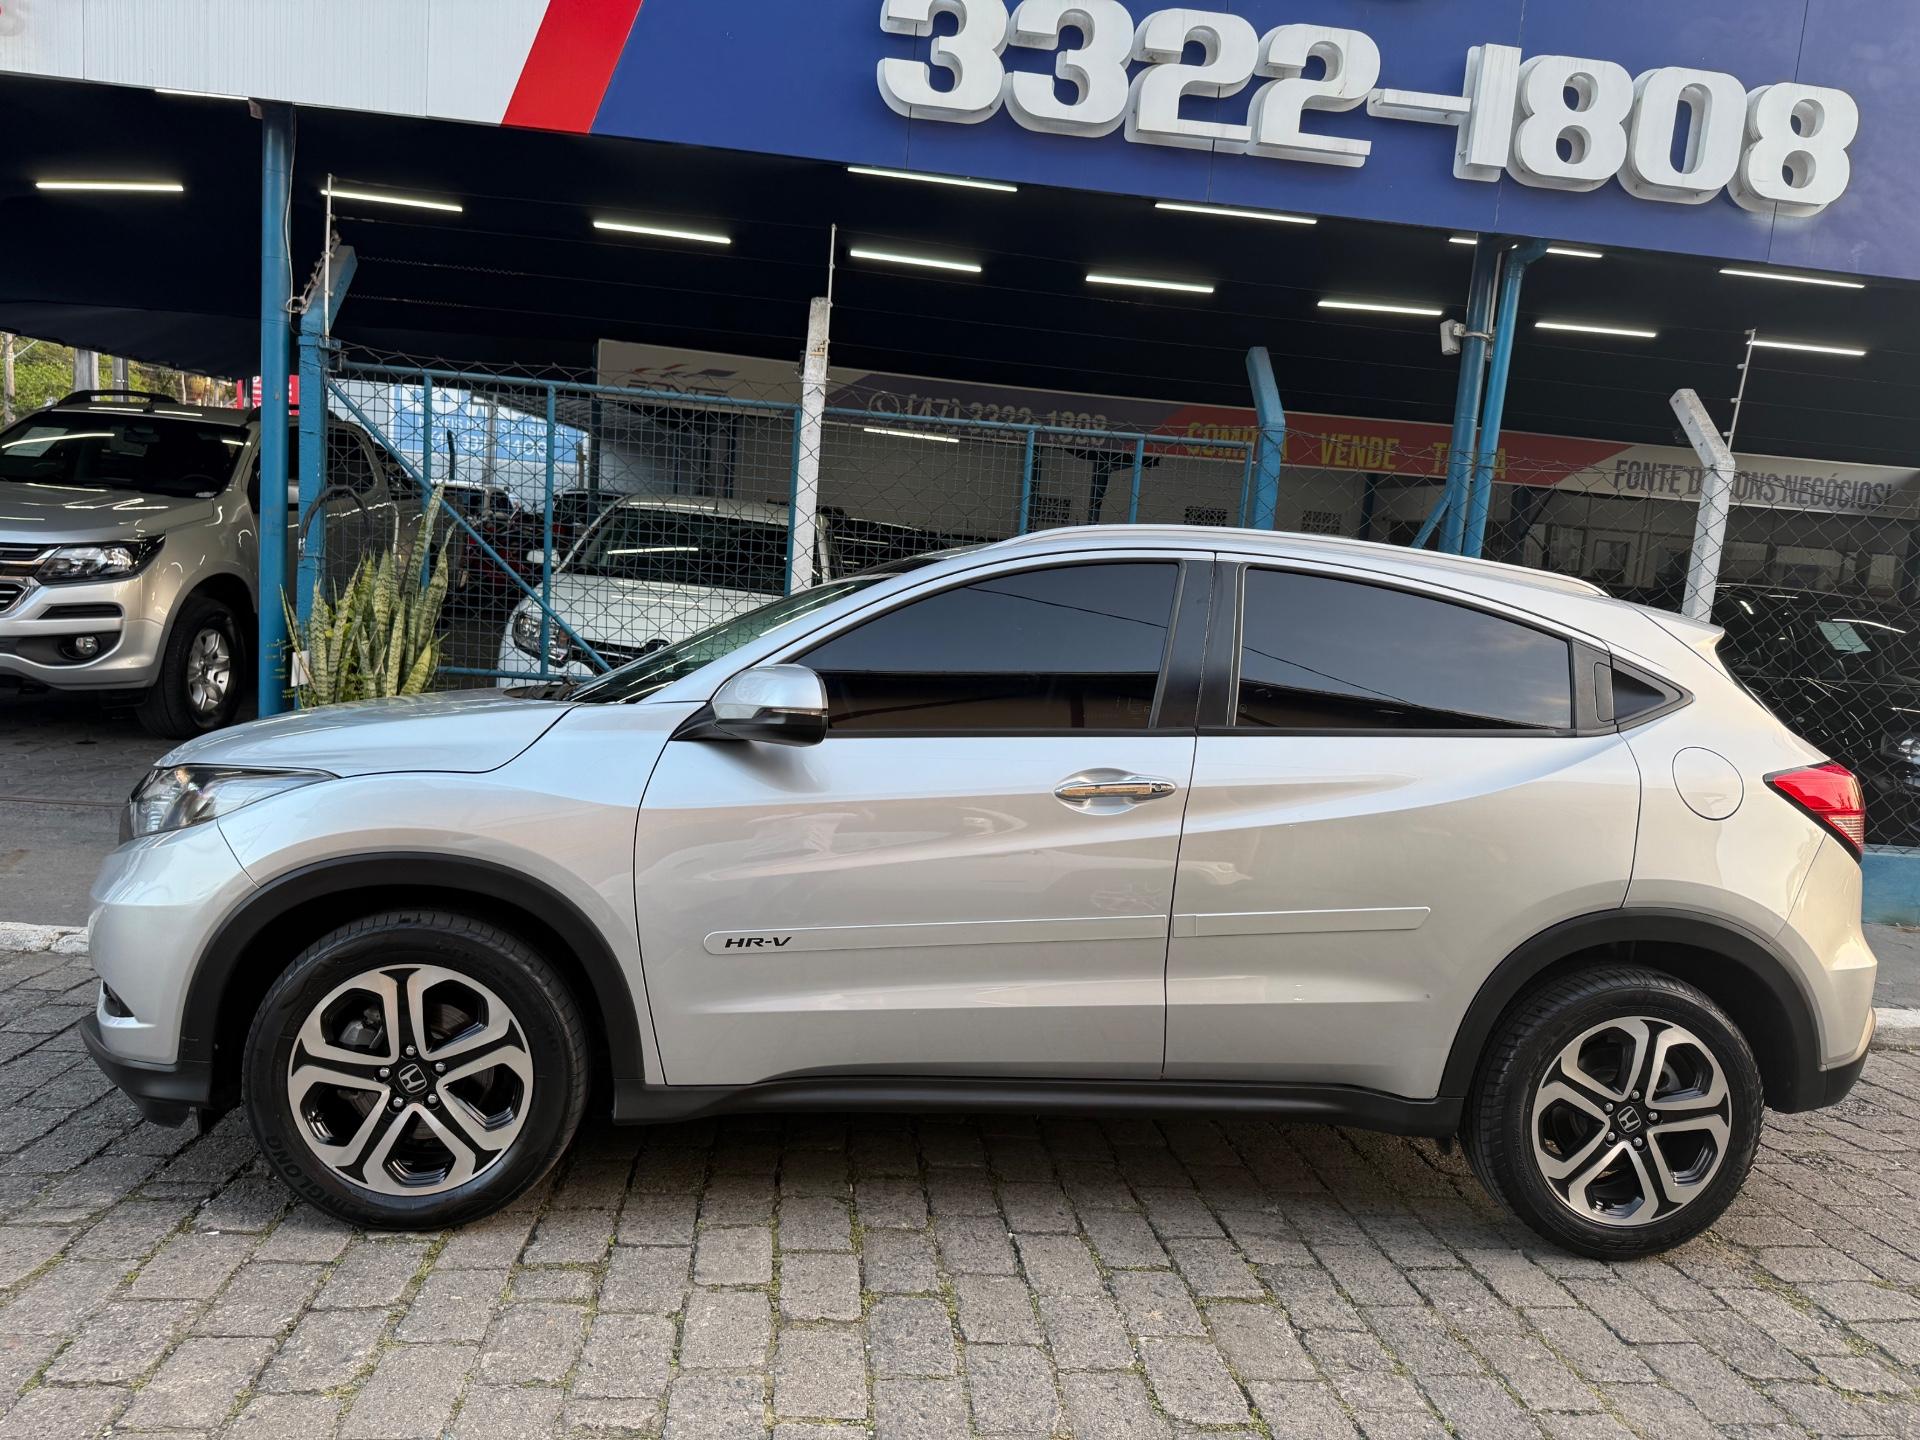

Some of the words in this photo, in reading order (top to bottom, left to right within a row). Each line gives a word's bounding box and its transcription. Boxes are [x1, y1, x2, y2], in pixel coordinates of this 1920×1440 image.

[878, 0, 1860, 217] 3322-1808
[1321, 432, 1399, 470] VENDE
[1614, 460, 1683, 494] FONTE
[1731, 470, 1778, 501] ONS
[725, 937, 792, 948] HR-V
